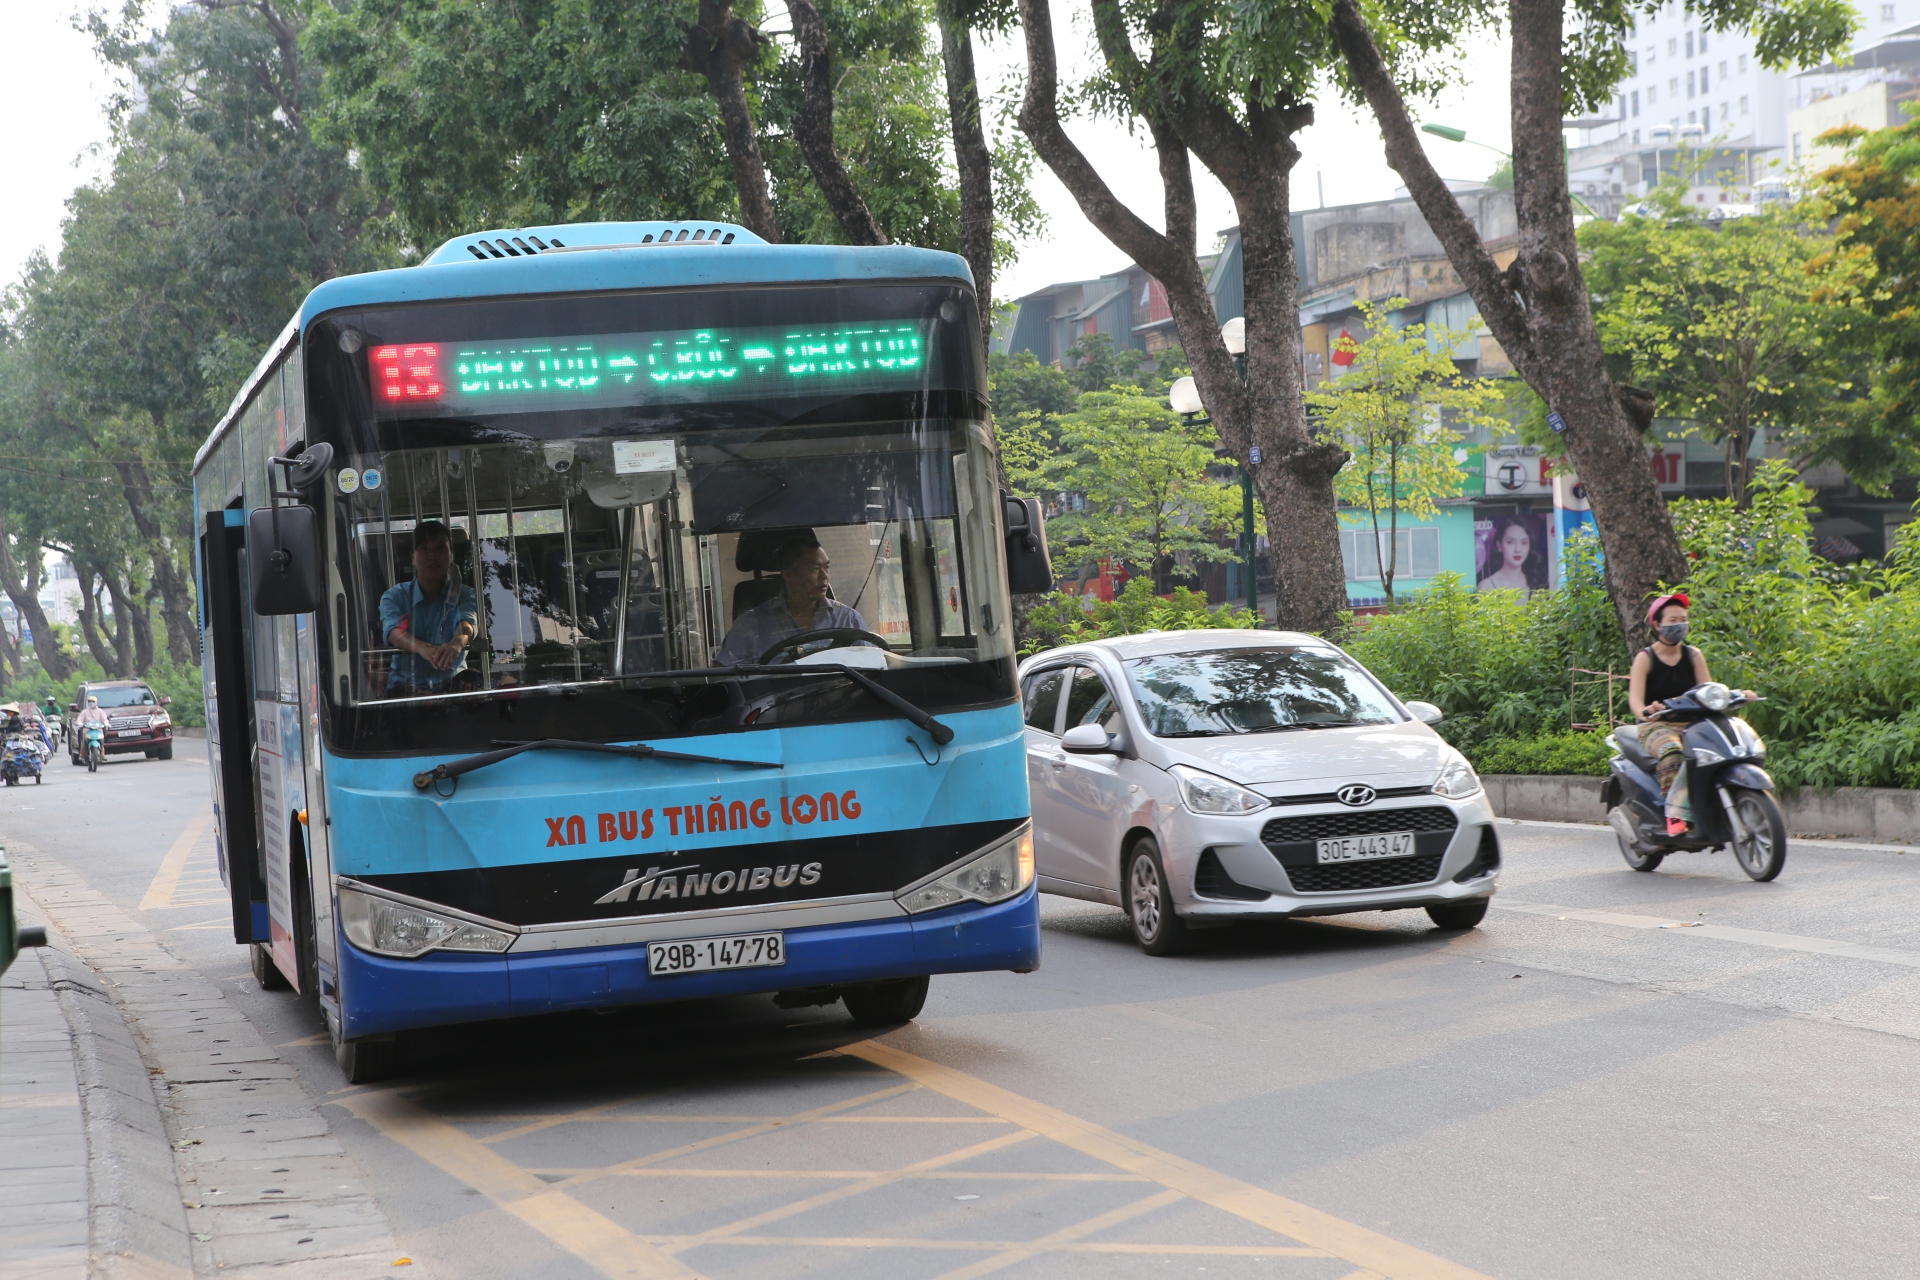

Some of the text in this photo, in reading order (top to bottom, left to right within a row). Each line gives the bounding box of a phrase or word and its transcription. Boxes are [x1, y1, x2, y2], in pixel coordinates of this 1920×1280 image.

[544, 790, 862, 847] XN BUS THĂNG LONG
[1320, 835, 1410, 860] 30E-443.47
[593, 862, 823, 905] HANOIBUS
[653, 936, 780, 972] 29B-147.78
